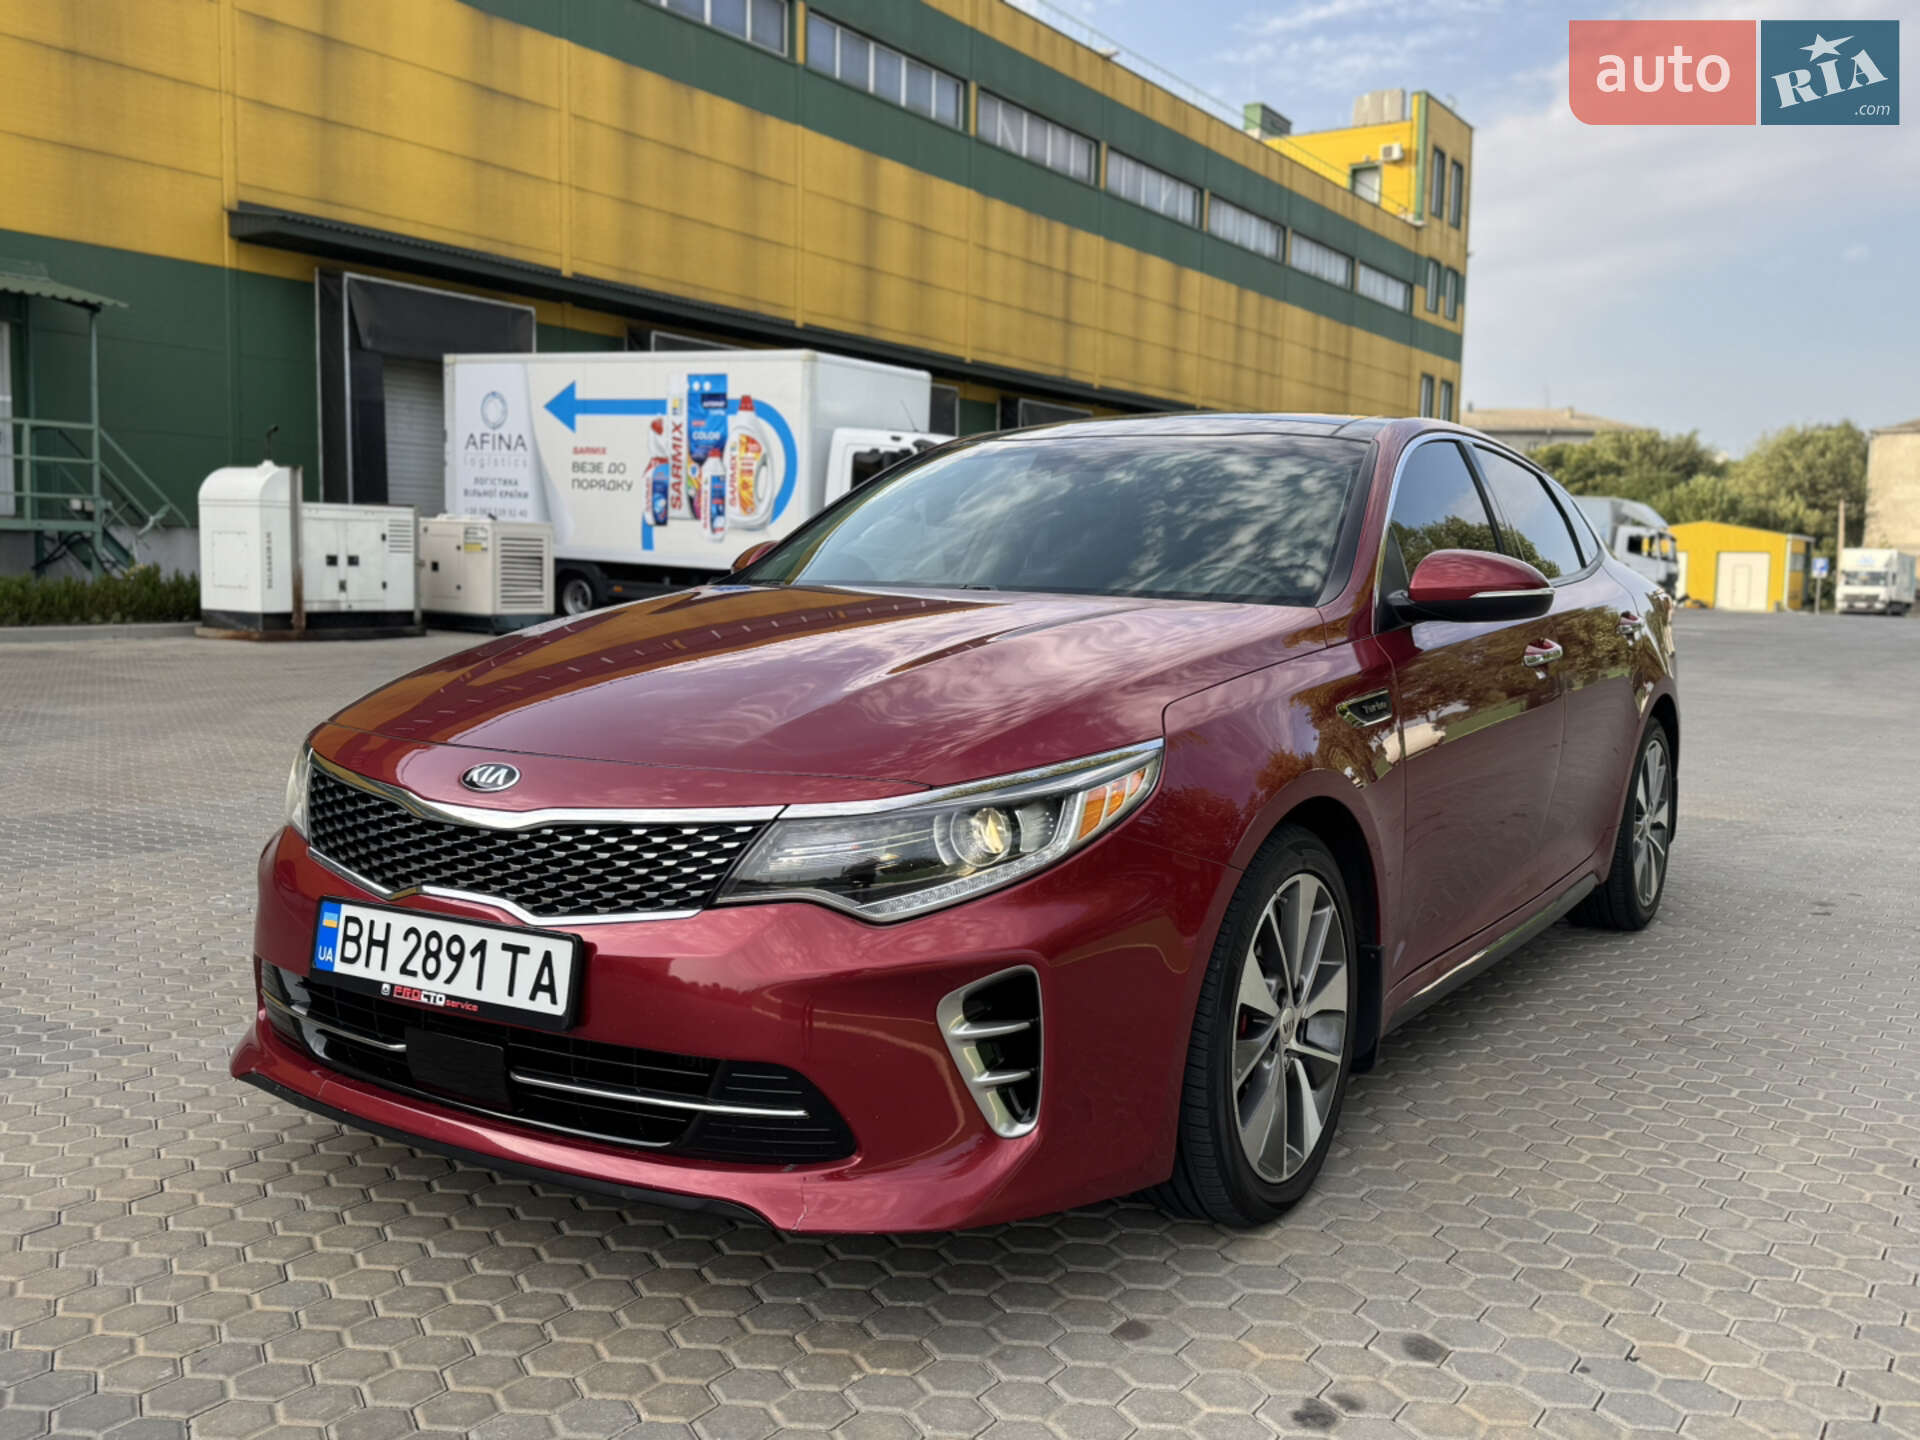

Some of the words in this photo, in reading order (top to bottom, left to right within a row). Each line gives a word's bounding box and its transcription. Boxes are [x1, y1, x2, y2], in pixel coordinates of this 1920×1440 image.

[464, 432, 528, 452] AFINA
[463, 454, 529, 469] logistics
[571, 461, 604, 474] ВЕЗЕ
[607, 462, 627, 474] ДО
[671, 421, 684, 511] SARMIX
[473, 476, 519, 487] ЛОГІСТИКА
[571, 478, 633, 492] ПОРЯДКУ
[464, 766, 509, 786] KIA
[318, 945, 334, 963] UA
[340, 915, 392, 971] BH
[399, 926, 488, 992] 2891
[500, 942, 559, 1006] TA
